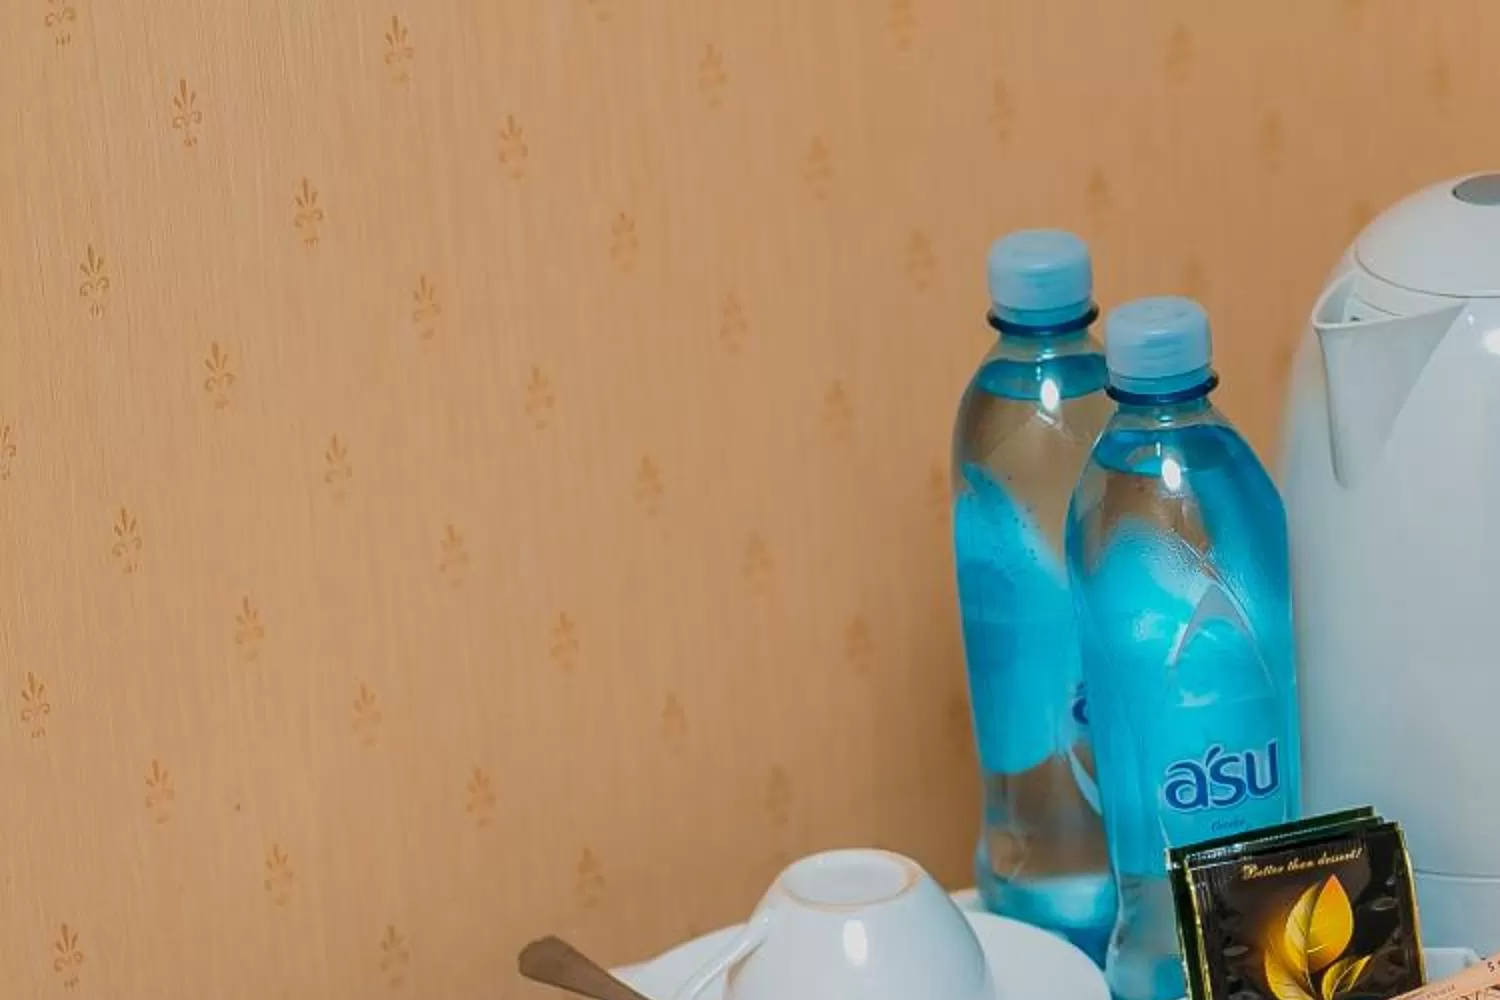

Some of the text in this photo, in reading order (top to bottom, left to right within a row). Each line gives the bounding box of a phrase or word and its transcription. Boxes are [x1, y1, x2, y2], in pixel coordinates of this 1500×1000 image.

[1242, 847, 1362, 880] Better than dessert!
